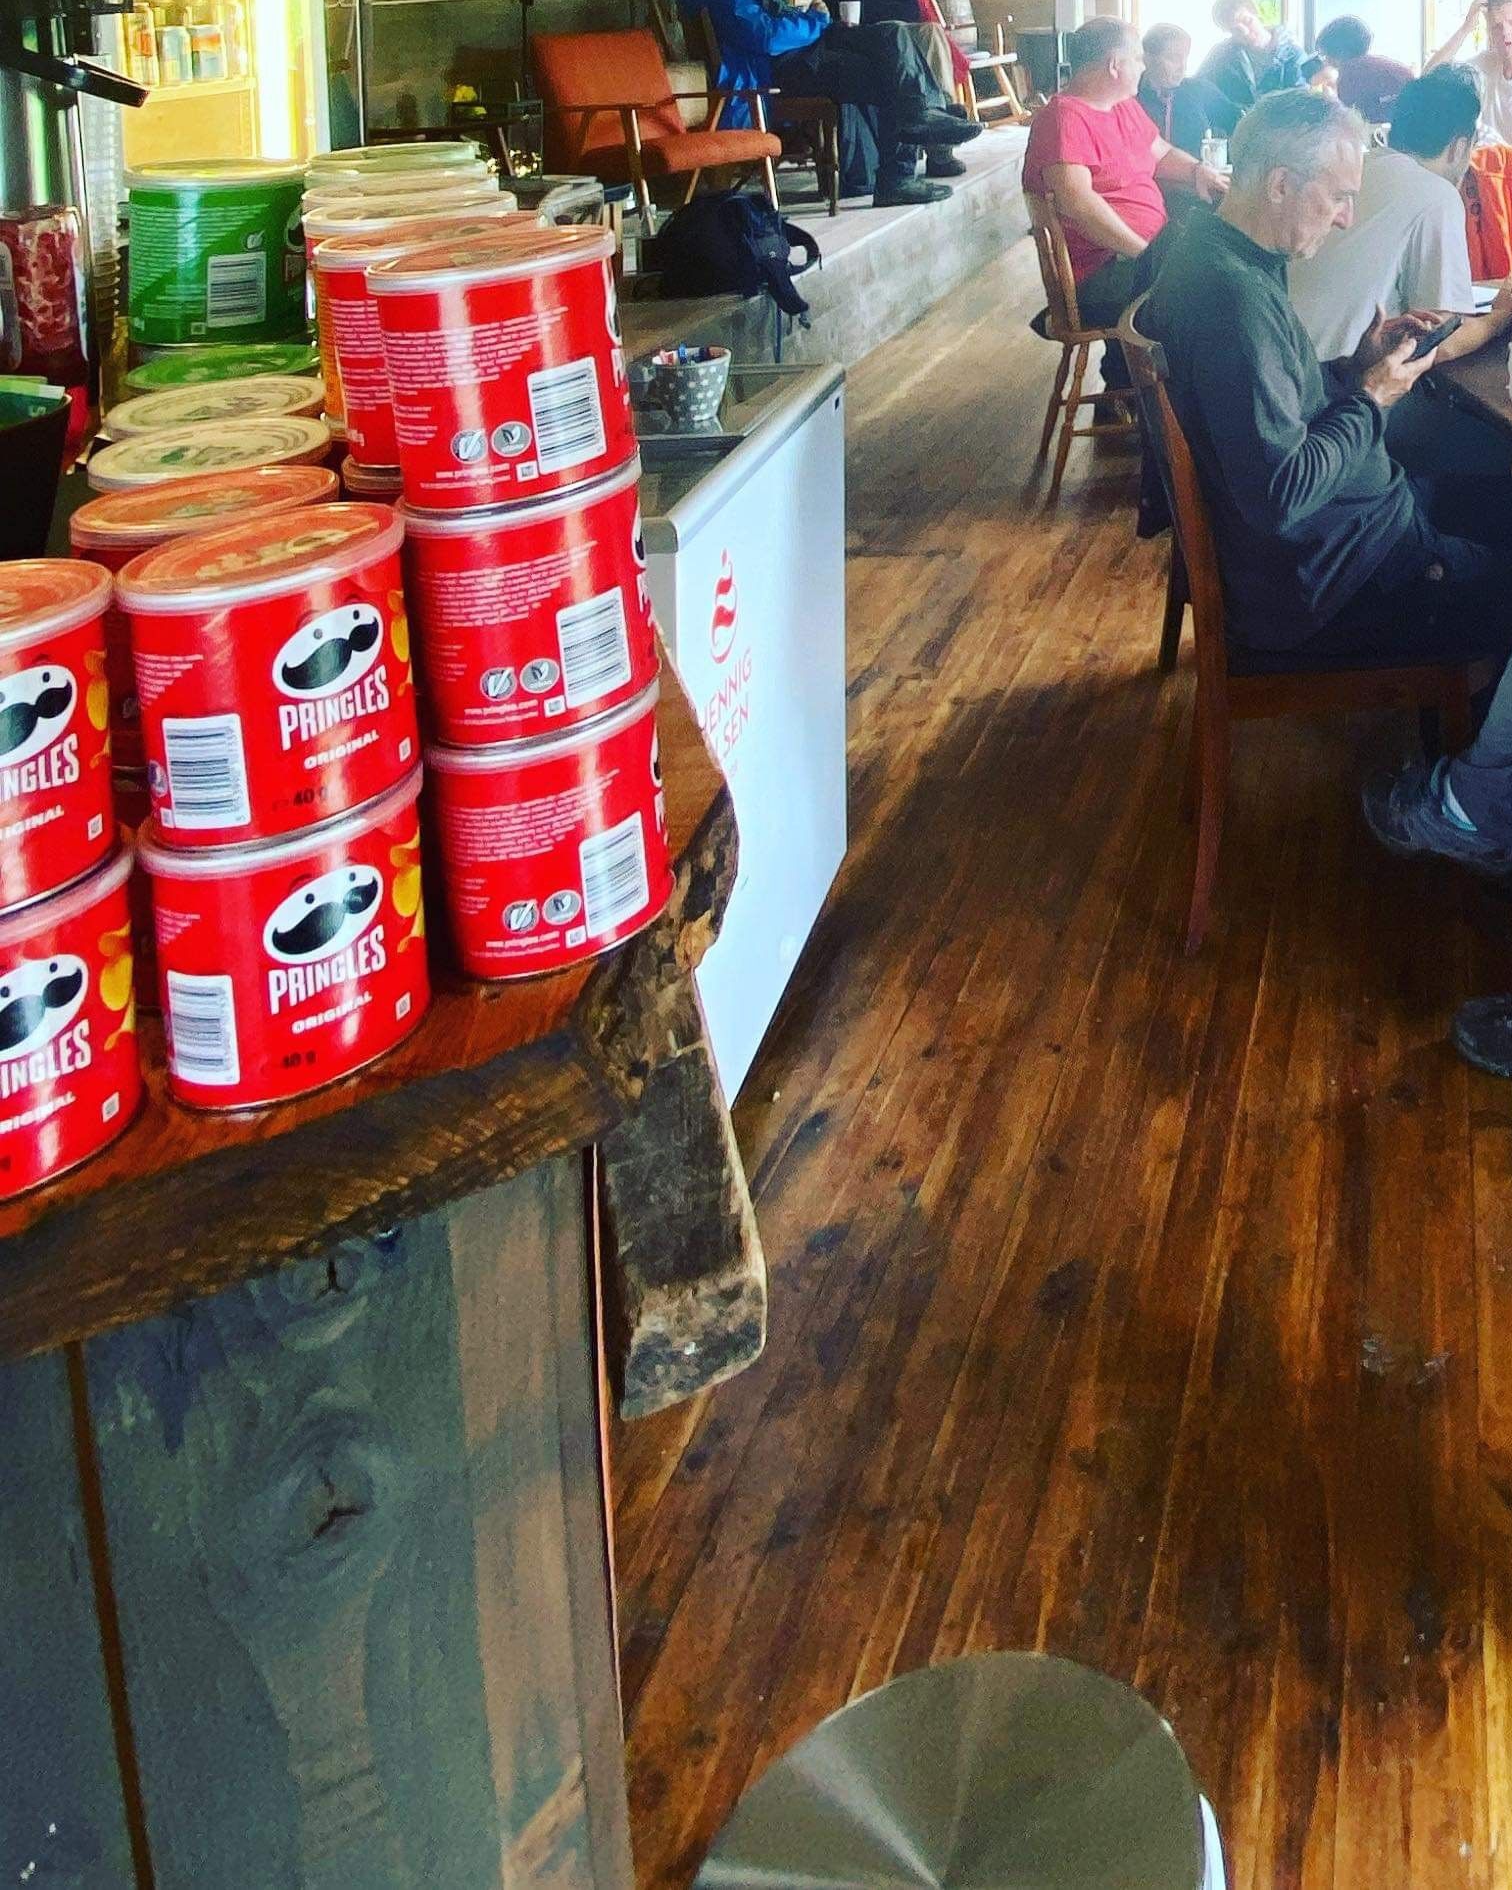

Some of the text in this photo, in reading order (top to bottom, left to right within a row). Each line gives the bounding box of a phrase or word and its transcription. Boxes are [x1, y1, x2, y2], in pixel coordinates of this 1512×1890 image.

[279, 665, 390, 751] PRINGLES
[0, 733, 80, 802] NGLES
[304, 729, 379, 770] ORIGINAL
[268, 925, 386, 1015] PRINGLES
[292, 991, 372, 1034] ORIGINAL
[0, 1018, 91, 1099] INGLES
